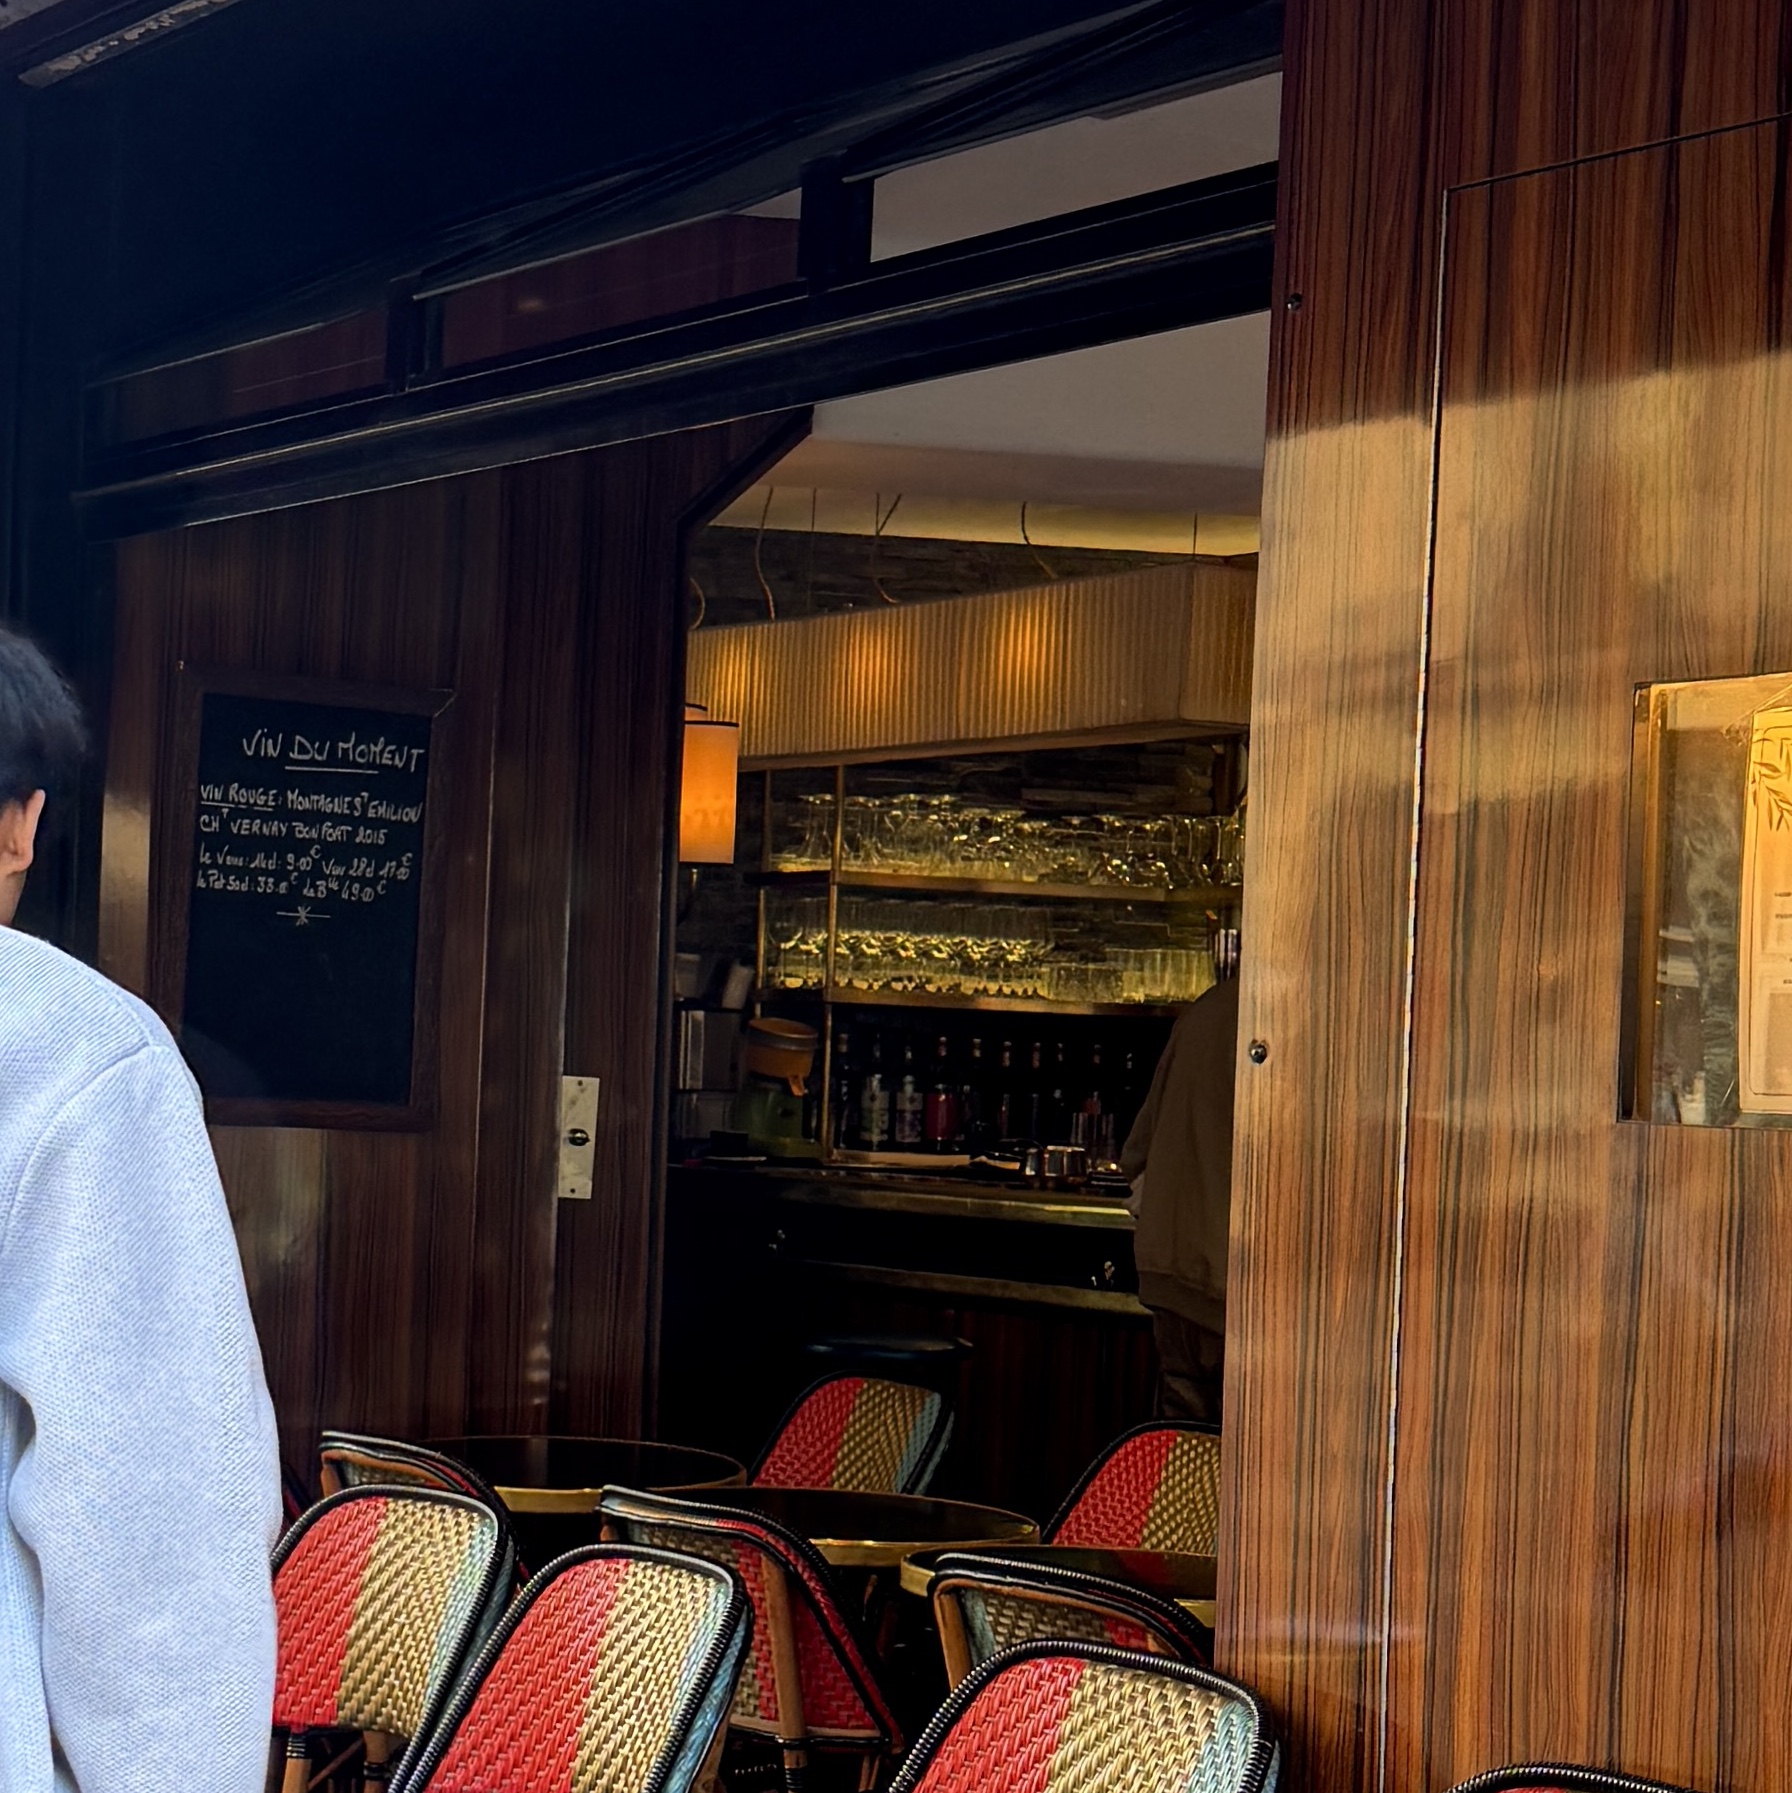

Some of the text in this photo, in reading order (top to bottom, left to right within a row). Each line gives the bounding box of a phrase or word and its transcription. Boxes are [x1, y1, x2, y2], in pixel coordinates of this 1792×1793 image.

[288, 735, 330, 762] DU
[337, 731, 425, 773] MOMENT
[355, 826, 388, 845] 2015
